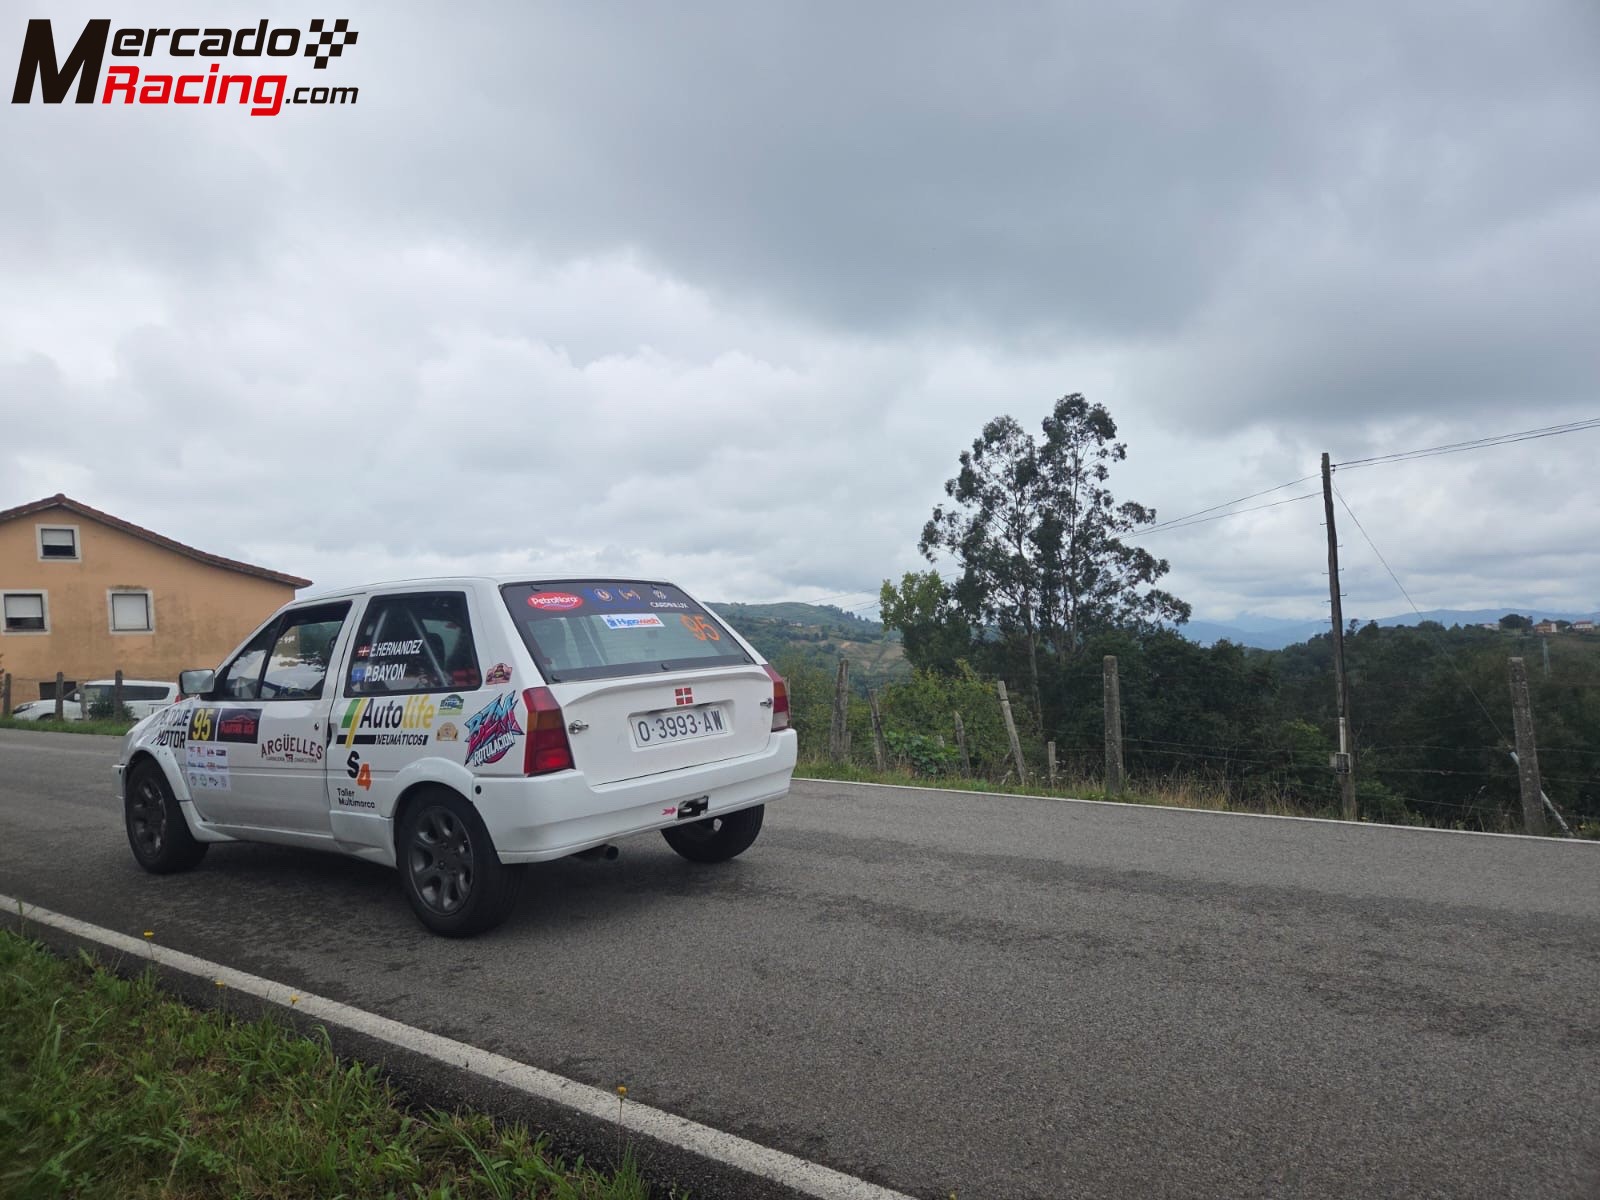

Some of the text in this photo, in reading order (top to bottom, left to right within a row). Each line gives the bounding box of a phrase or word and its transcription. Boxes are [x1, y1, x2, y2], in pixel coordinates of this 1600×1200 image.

[680, 614, 720, 641] 95
[369, 639, 423, 658] E.HERNANDEZ
[364, 663, 407, 682] P.BAYON
[192, 708, 215, 741] 95
[359, 694, 435, 729] Autolife
[150, 729, 187, 749] MOTOR
[261, 734, 324, 760] ARGÜELLES
